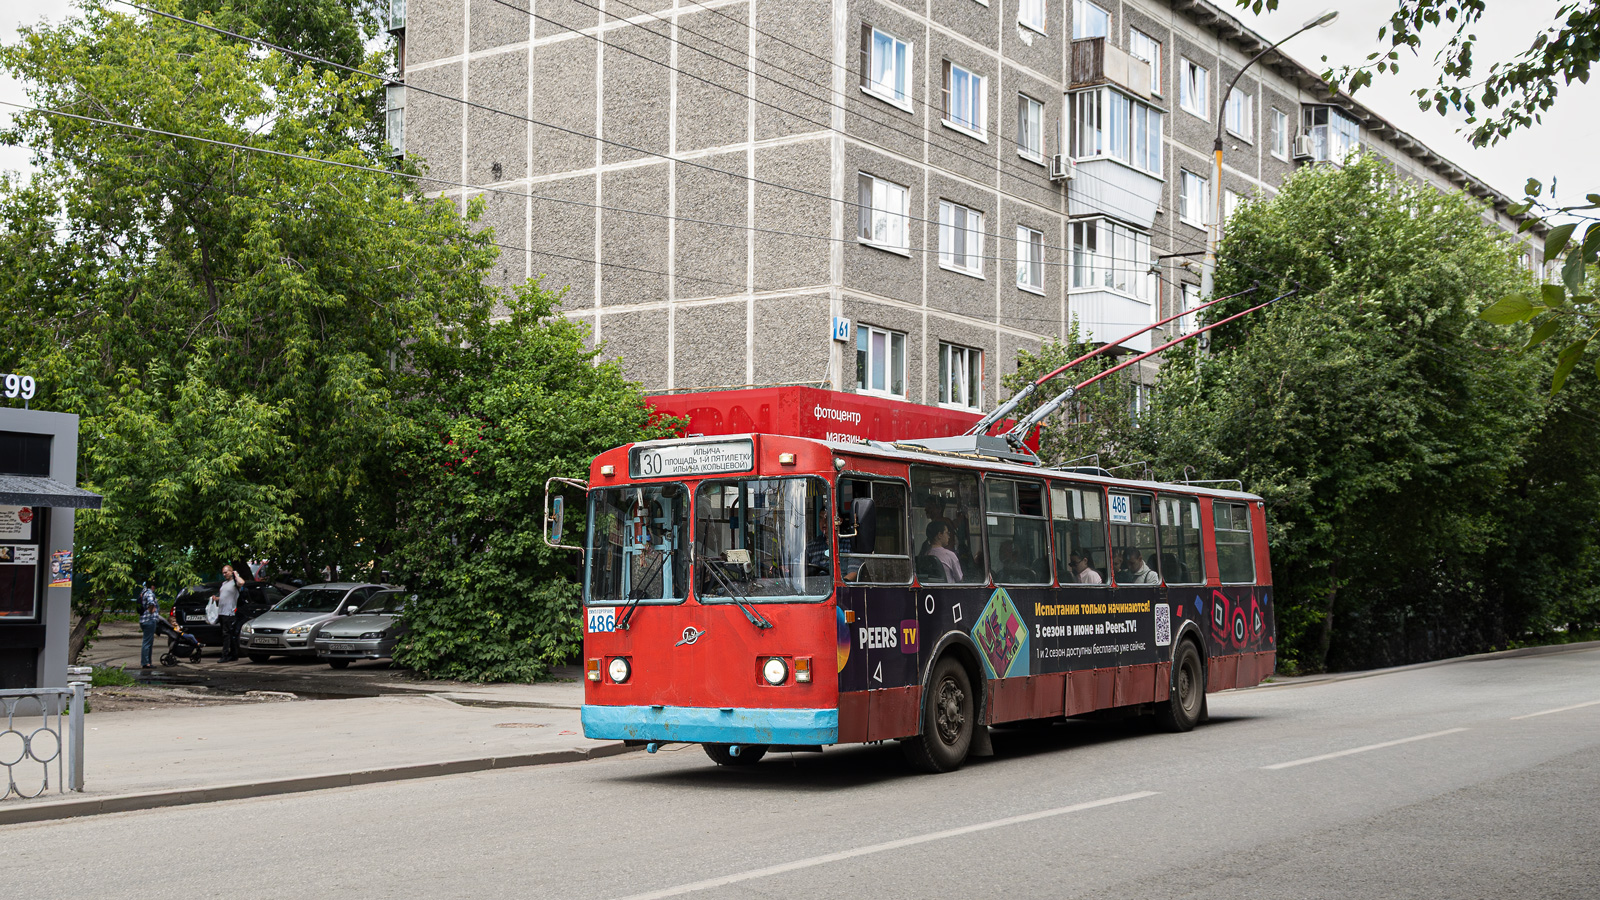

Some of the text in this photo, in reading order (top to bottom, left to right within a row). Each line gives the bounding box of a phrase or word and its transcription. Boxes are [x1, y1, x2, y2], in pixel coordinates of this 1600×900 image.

[839, 321, 848, 337] 61
[5, 374, 35, 400] 99
[814, 403, 861, 426] фотоцентр
[664, 453, 752, 466] ПЛОЩАДЬ 1-Й ПЯТИЛЕТКИ
[693, 447, 721, 456] ИЛЬИЧА
[643, 453, 662, 475] 30
[700, 460, 748, 472] (КОЛЬЦЕВОЙ)
[1112, 496, 1127, 513] 486
[1035, 600, 1150, 616] Испытания только начинаются!
[589, 615, 614, 632] 486
[1035, 620, 1137, 638] 3 сезон в июне на Peers.TV!
[859, 626, 917, 650] PEERS TV
[1040, 650, 1044, 658] и
[1045, 648, 1049, 658] 2
[1049, 648, 1066, 658] сезон
[1066, 647, 1092, 658] доступны
[1092, 643, 1119, 655] бесплатно
[1119, 643, 1129, 654] уже
[1129, 641, 1146, 652] сейчас
